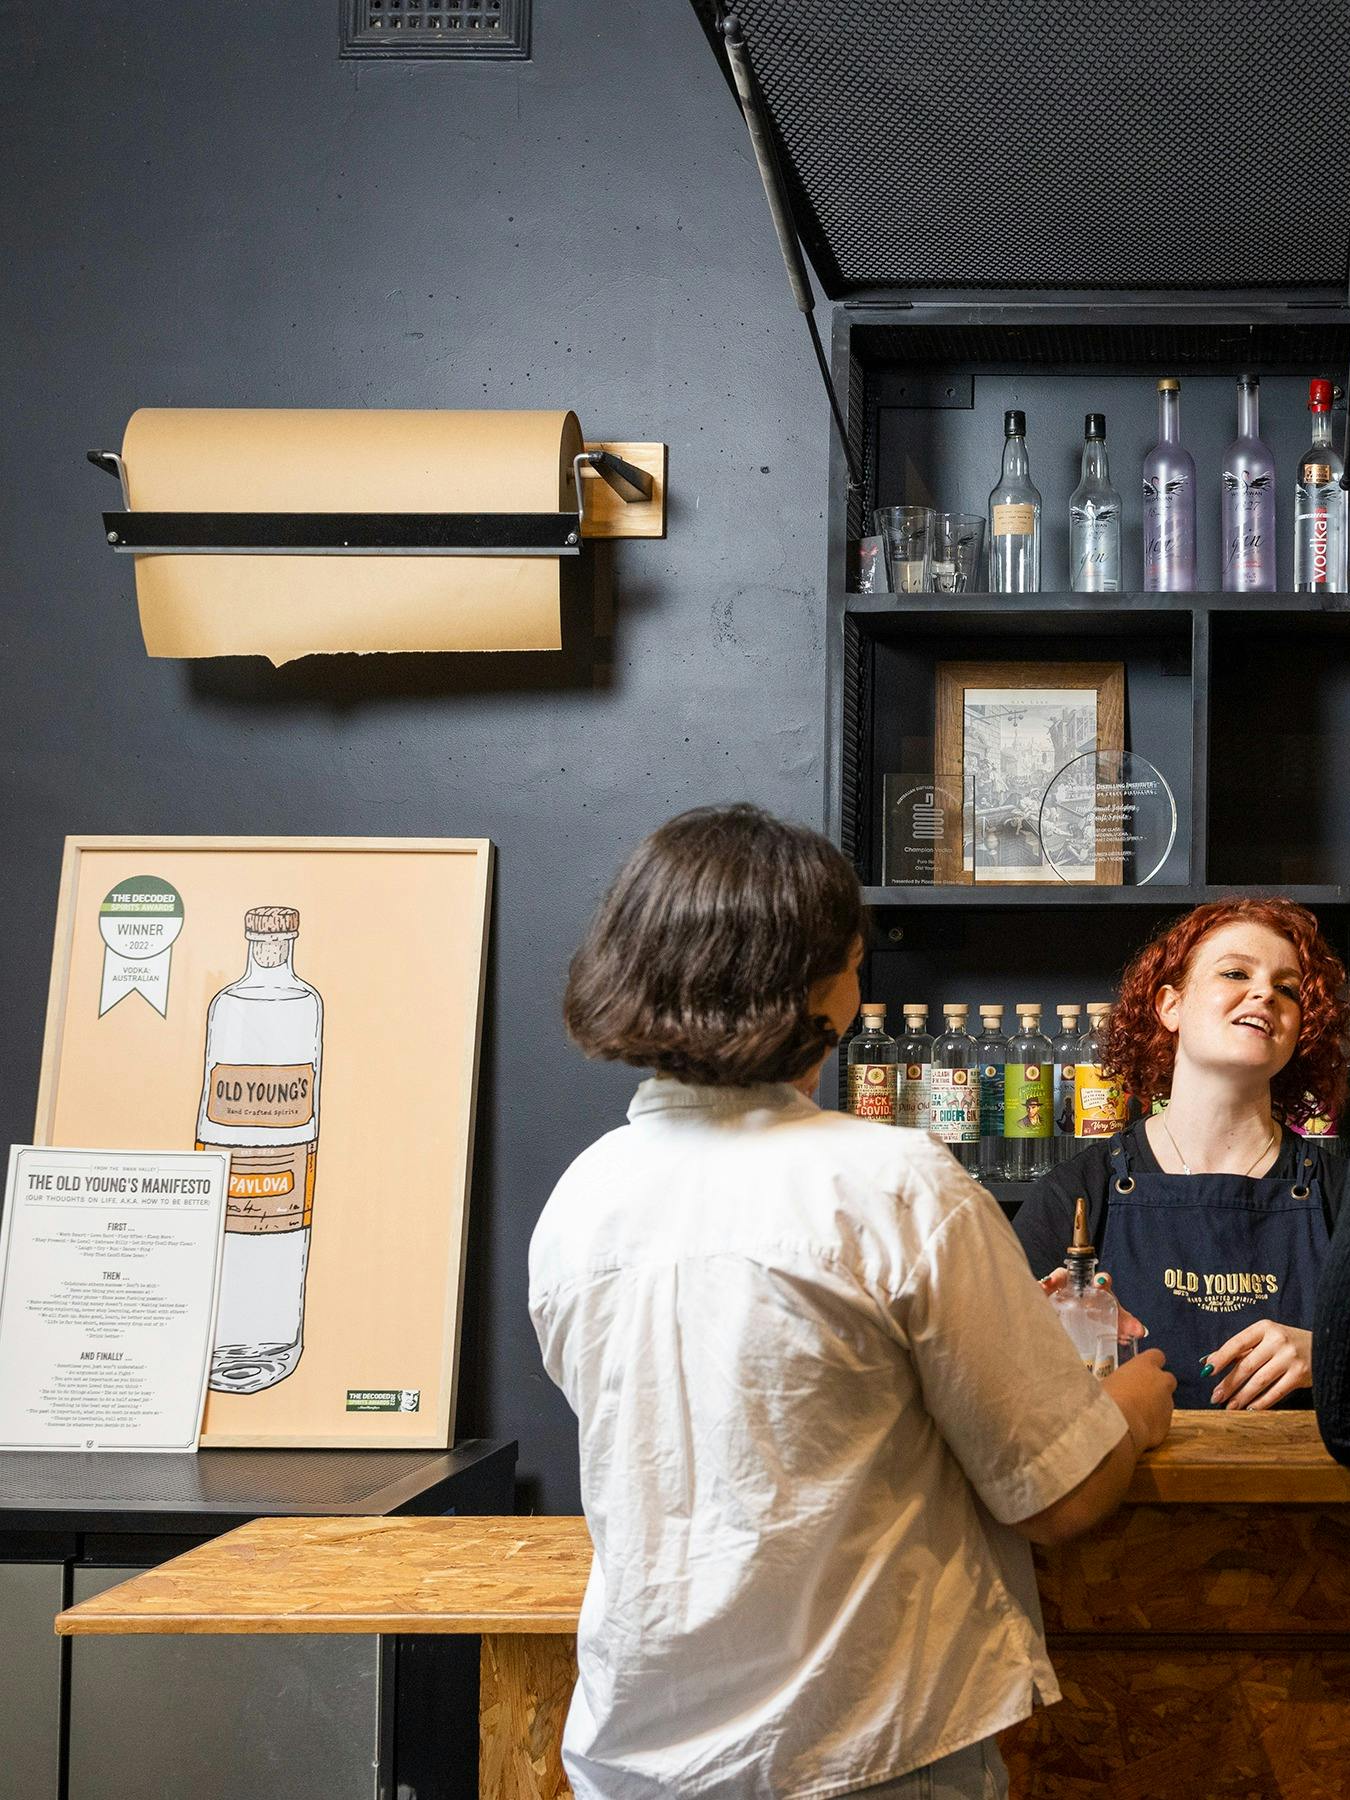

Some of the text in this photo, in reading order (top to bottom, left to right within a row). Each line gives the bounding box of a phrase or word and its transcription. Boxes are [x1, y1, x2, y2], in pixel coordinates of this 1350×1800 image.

[1309, 520, 1327, 580] vodka
[112, 894, 175, 903] THE DECODED
[118, 924, 164, 935] WINNER
[129, 941, 149, 949] 2022
[216, 1078, 308, 1102] OLD YOUNG'S
[940, 1110, 965, 1121] CIDER
[28, 1174, 211, 1194] THE OLD YOUNG'S MANIFESTO
[230, 1176, 289, 1193] PAVLOVA
[107, 1222, 127, 1231] FIRST
[102, 1272, 121, 1280] THEN
[1164, 1269, 1278, 1295] OLD YOUNG'S
[1232, 1296, 1256, 1304] SPIRITS
[1201, 1303, 1242, 1312] SWAN VALLEY
[80, 1352, 94, 1360] AND
[97, 1352, 124, 1361] FINALLY
